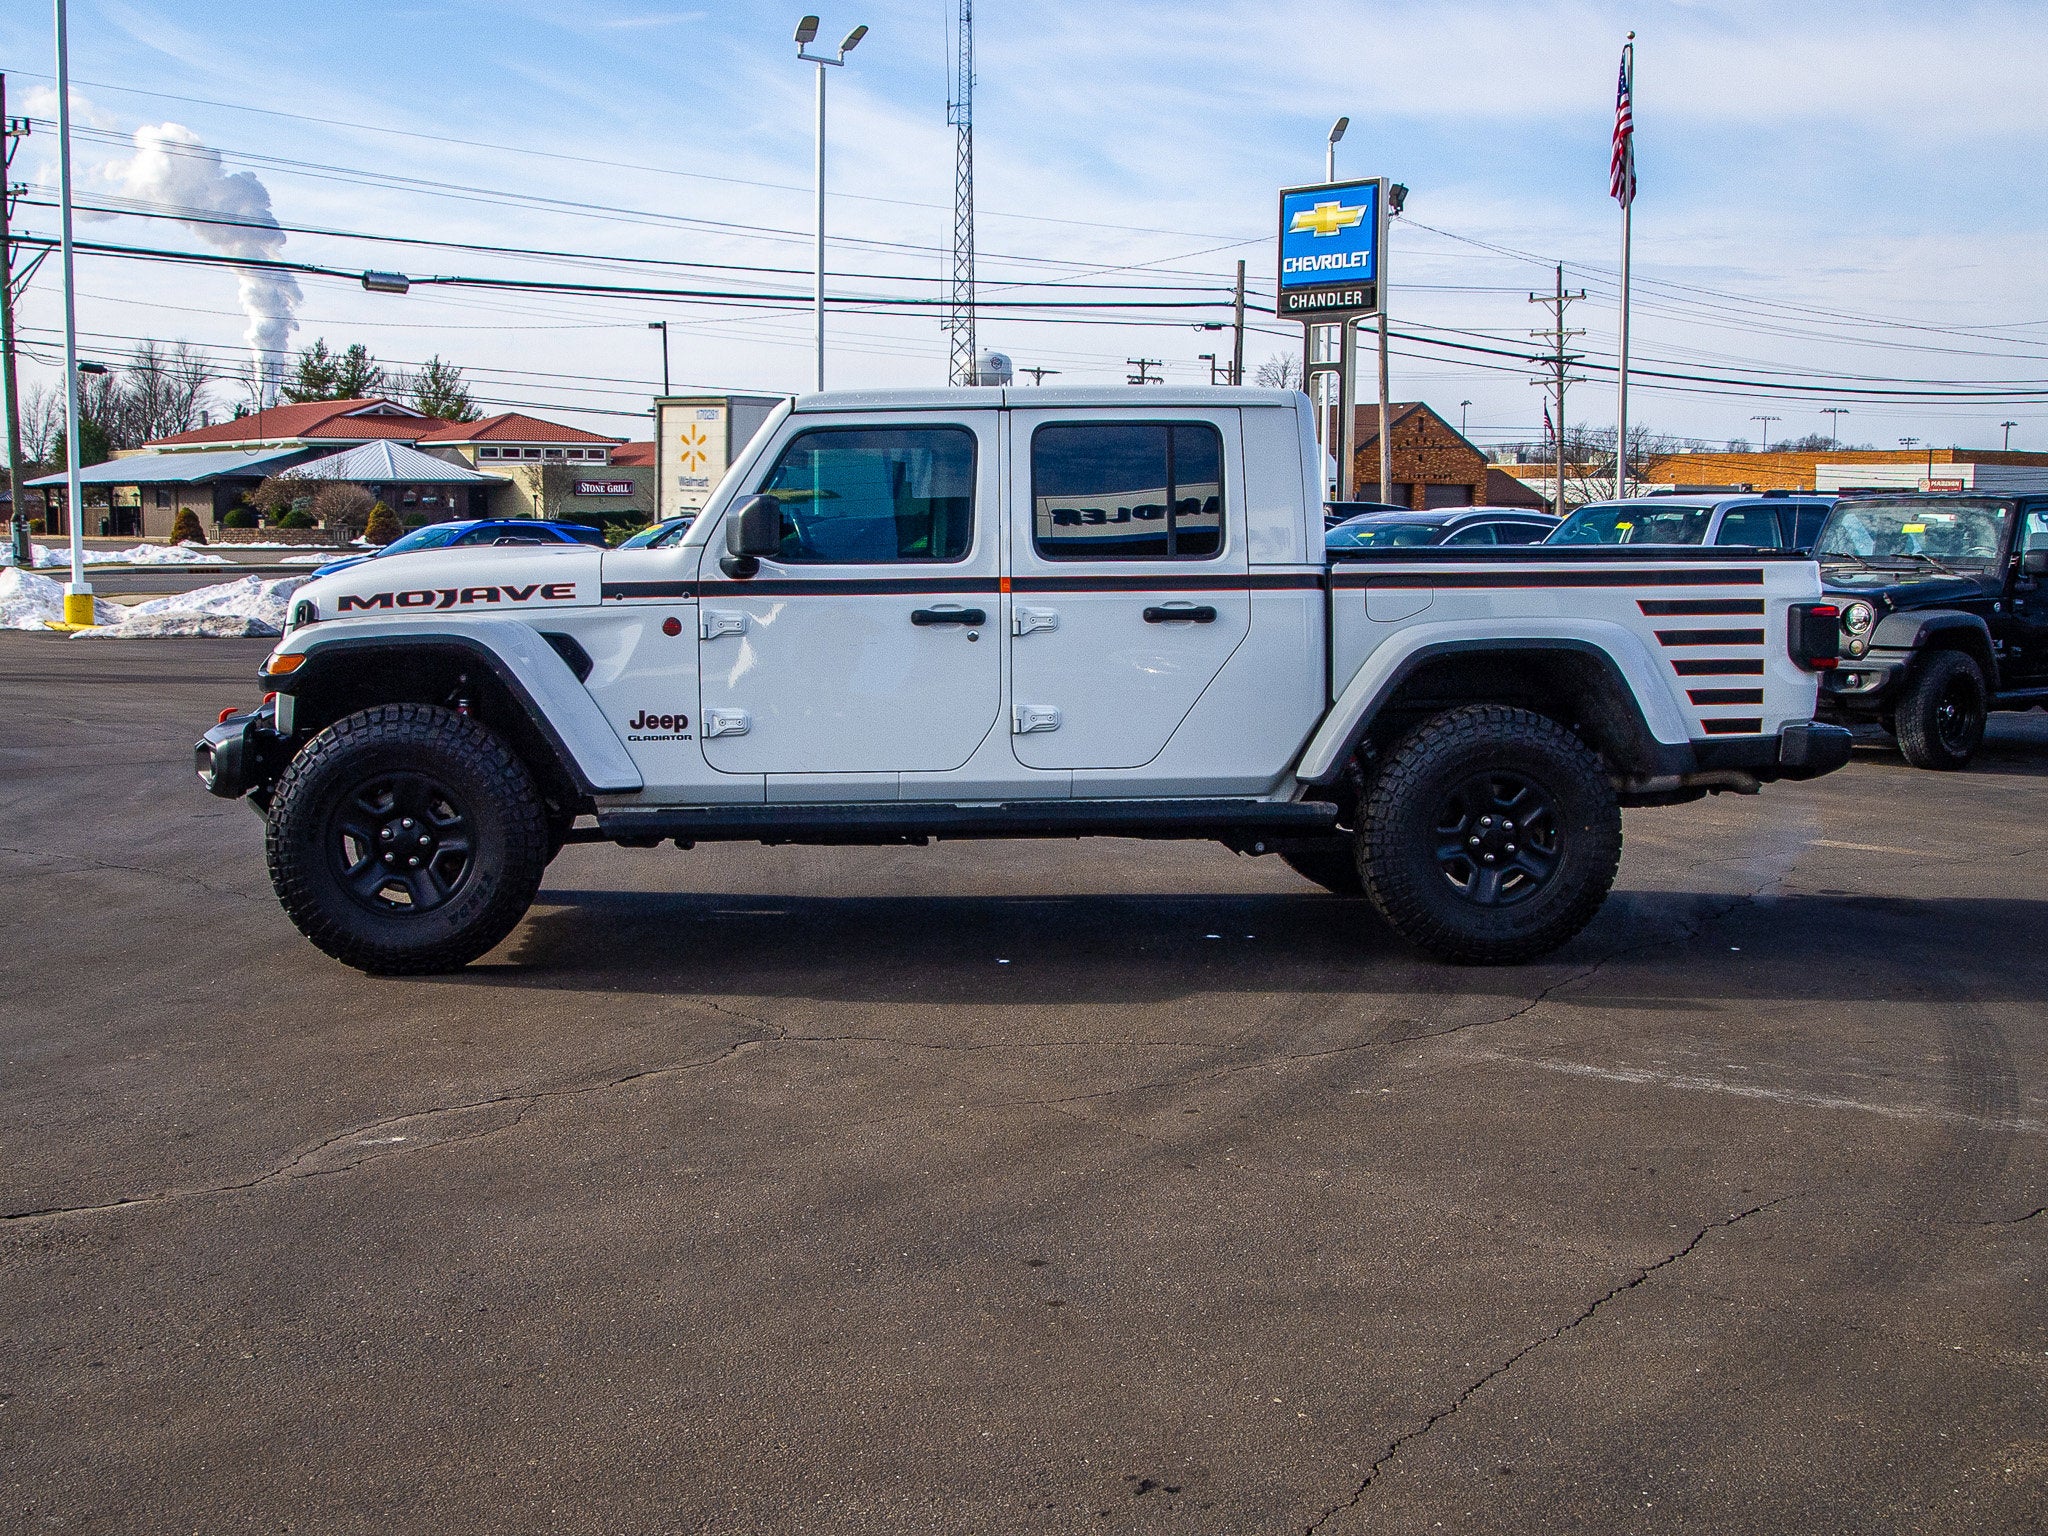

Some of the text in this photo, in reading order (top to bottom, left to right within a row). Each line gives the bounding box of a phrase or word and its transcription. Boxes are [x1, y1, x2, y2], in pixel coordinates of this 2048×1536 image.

[1283, 251, 1370, 273] CHEVROLET
[1289, 291, 1362, 308] CHANDLER
[581, 482, 629, 493] STONE GRILL
[678, 476, 709, 488] Walmart
[337, 582, 577, 612] MOJAVE
[629, 710, 689, 733] Jeep
[627, 734, 693, 742] GLADIATOR
